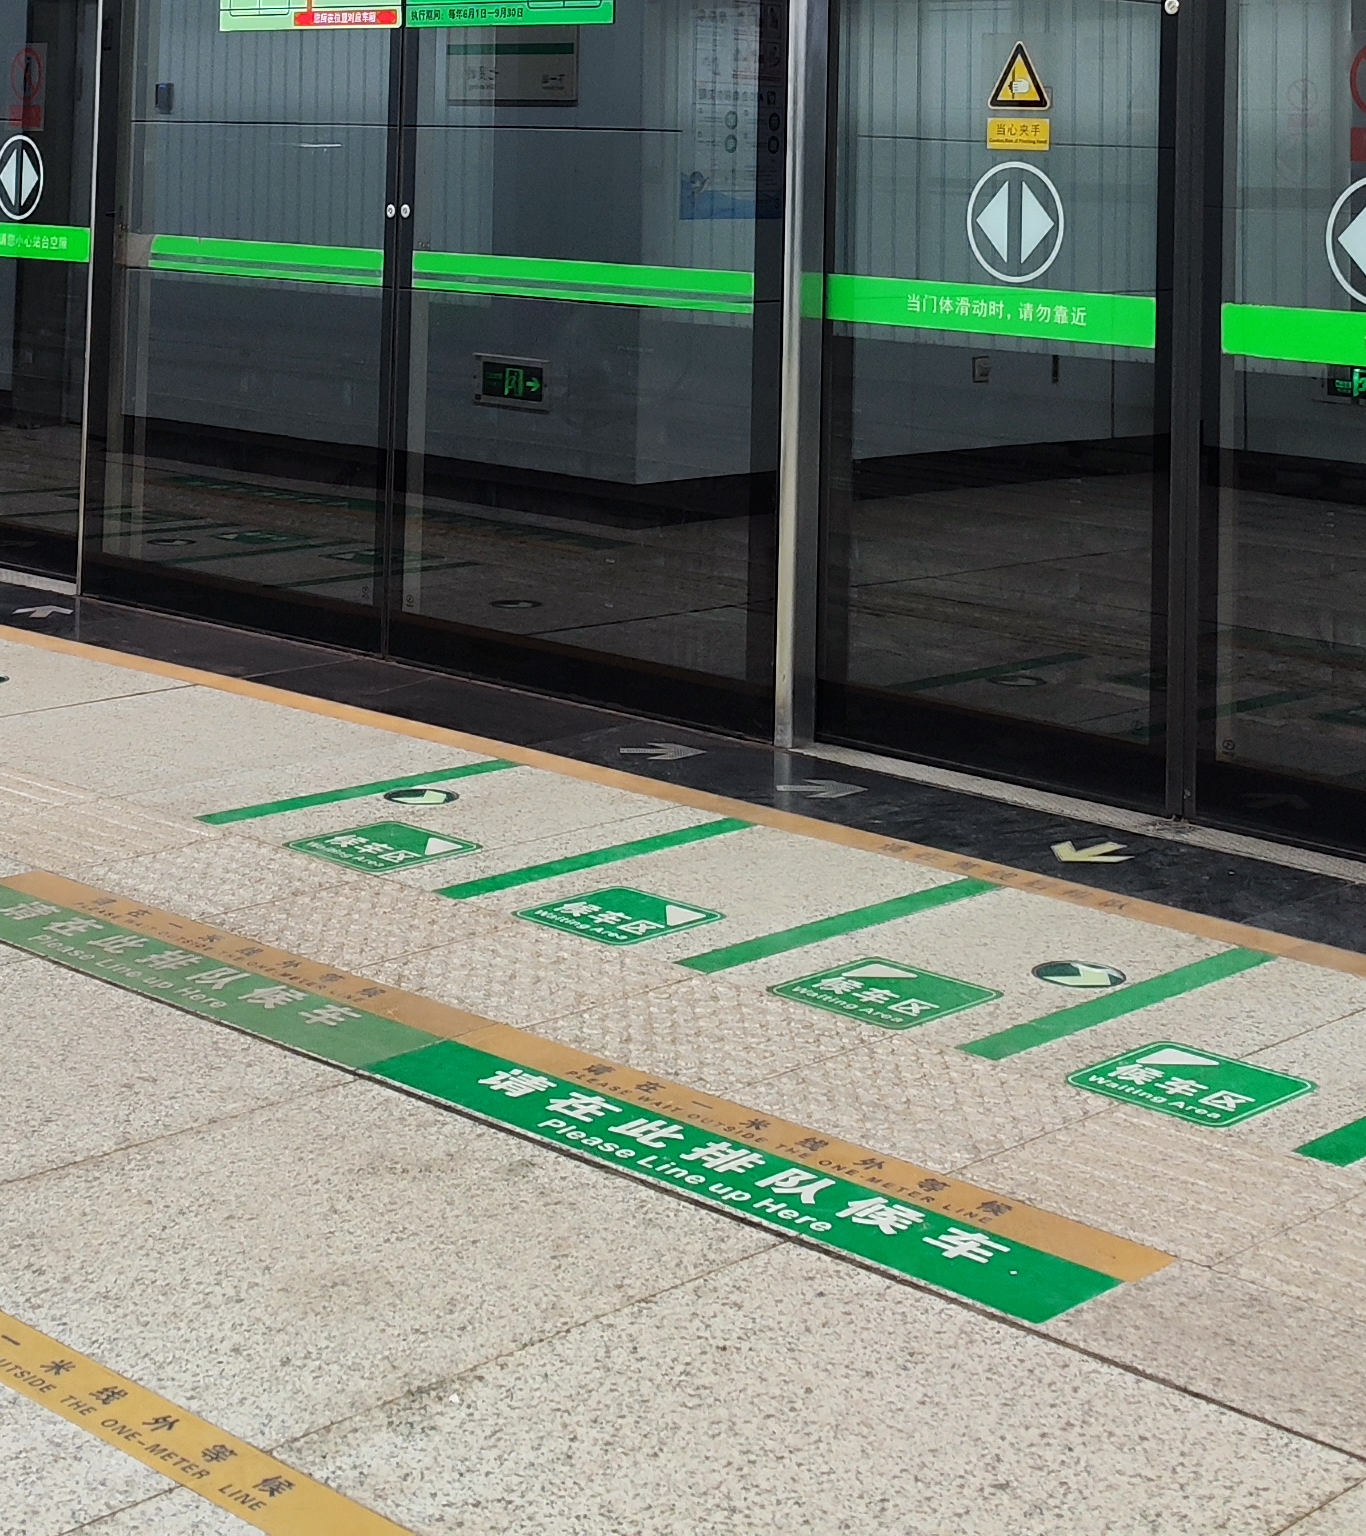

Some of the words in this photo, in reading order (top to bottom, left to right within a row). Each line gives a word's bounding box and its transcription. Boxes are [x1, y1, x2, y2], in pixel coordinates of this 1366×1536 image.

[996, 124, 1041, 137] 当心夹手
[324, 834, 423, 863] 候车区
[535, 909, 590, 929] Waiting
[589, 927, 628, 939] Area
[554, 901, 665, 935] 候车区
[28, 934, 95, 961] Please
[98, 959, 143, 979] Line
[143, 977, 174, 990] up
[173, 986, 228, 1009] Here
[792, 985, 858, 1010] Waiting
[858, 1007, 903, 1023] Area
[812, 976, 939, 1016] 候车区
[1088, 1074, 1168, 1104] Waiting
[1168, 1100, 1222, 1120] Area
[1108, 1063, 1256, 1113] 候车区
[565, 1070, 634, 1096] PLEASE
[637, 1095, 684, 1114] WAIT
[687, 1113, 769, 1144] OUTSIDE
[774, 1143, 812, 1159] THE
[818, 1159, 937, 1204] ONE-METER
[942, 1203, 994, 1225] LINE
[583, 1064, 1013, 1216] 请在一米线外等候
[478, 1068, 1011, 1264] 请在此排队候车
[537, 1118, 636, 1160] Please
[636, 1155, 706, 1185] Line
[708, 1182, 752, 1202] up
[752, 1197, 833, 1233] Here
[60, 1394, 96, 1418] THE
[99, 1416, 212, 1482] ONE-METER
[218, 1482, 269, 1514] LINE
